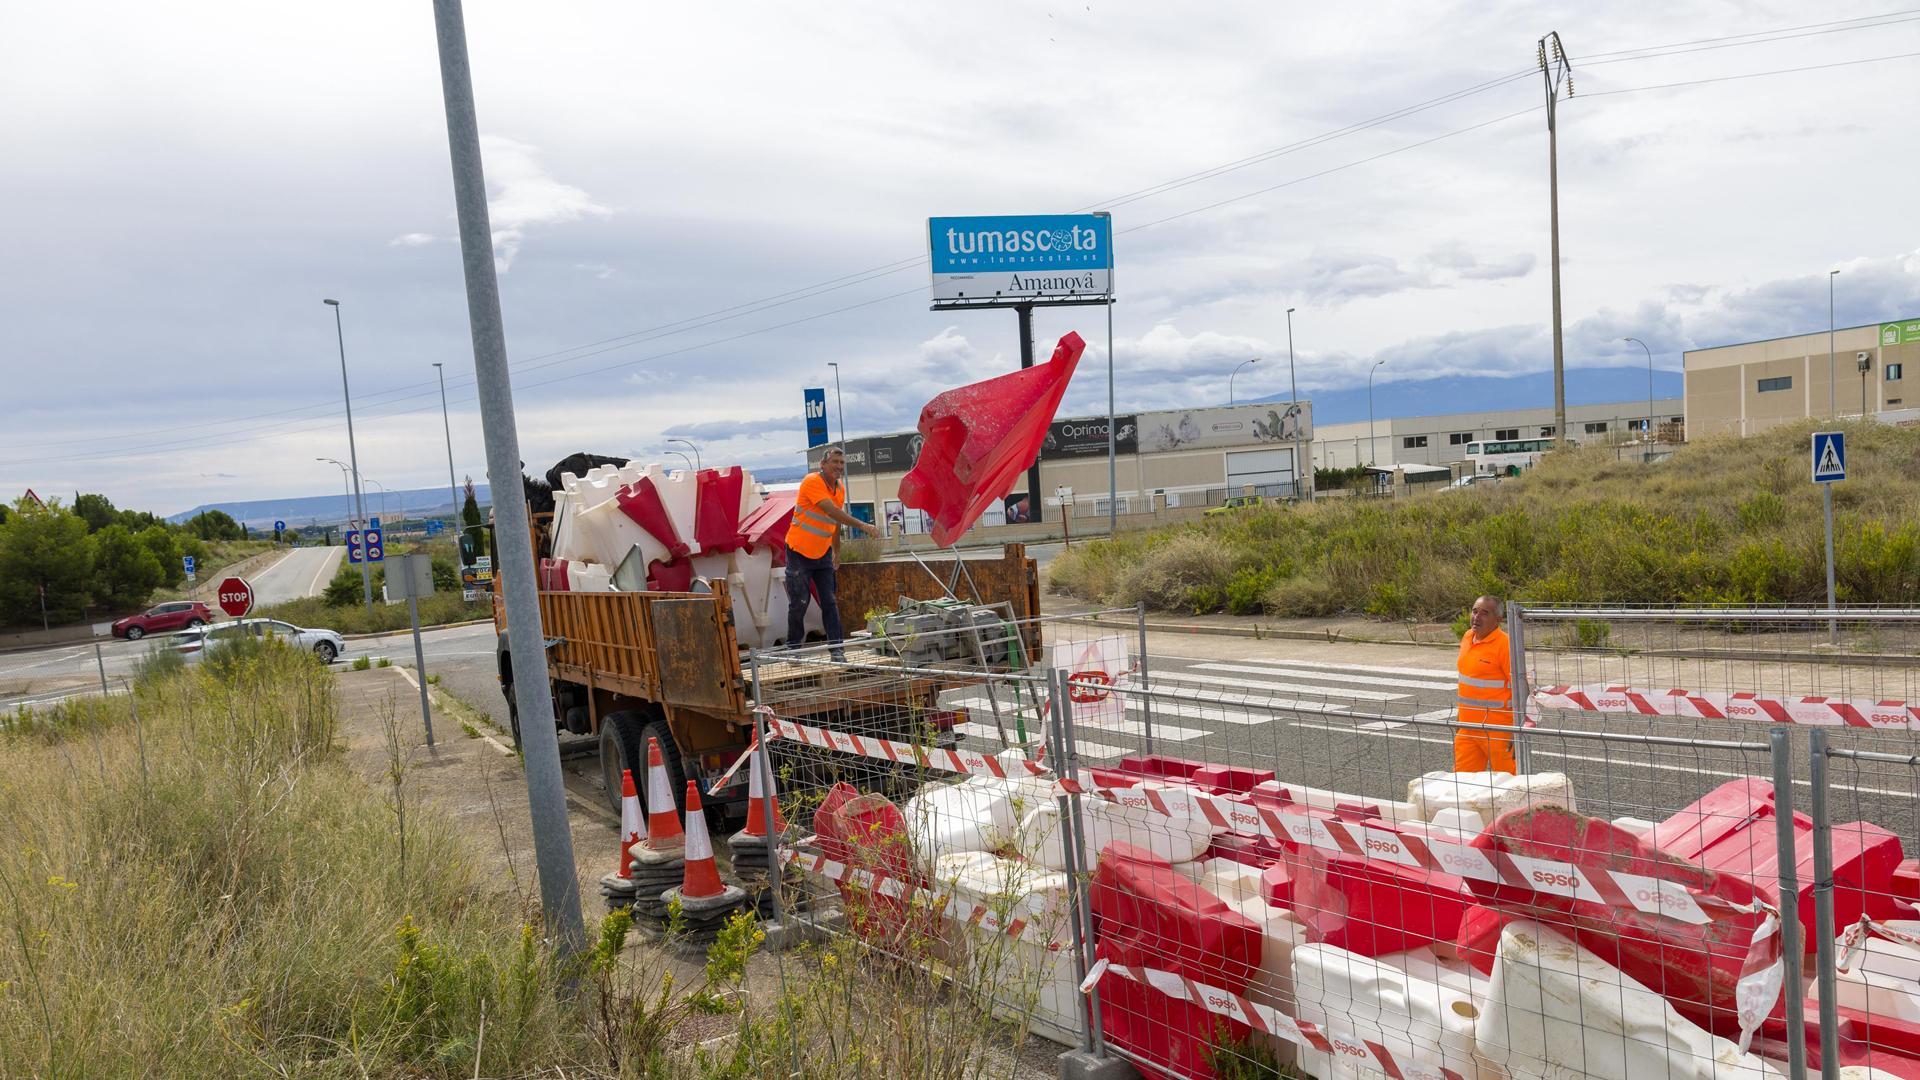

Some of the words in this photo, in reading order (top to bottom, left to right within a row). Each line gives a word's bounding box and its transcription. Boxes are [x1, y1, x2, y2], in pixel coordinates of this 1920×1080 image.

[949, 254, 1097, 265] www.tumascota.es
[806, 399, 824, 419] itv
[221, 592, 248, 603] STOP
